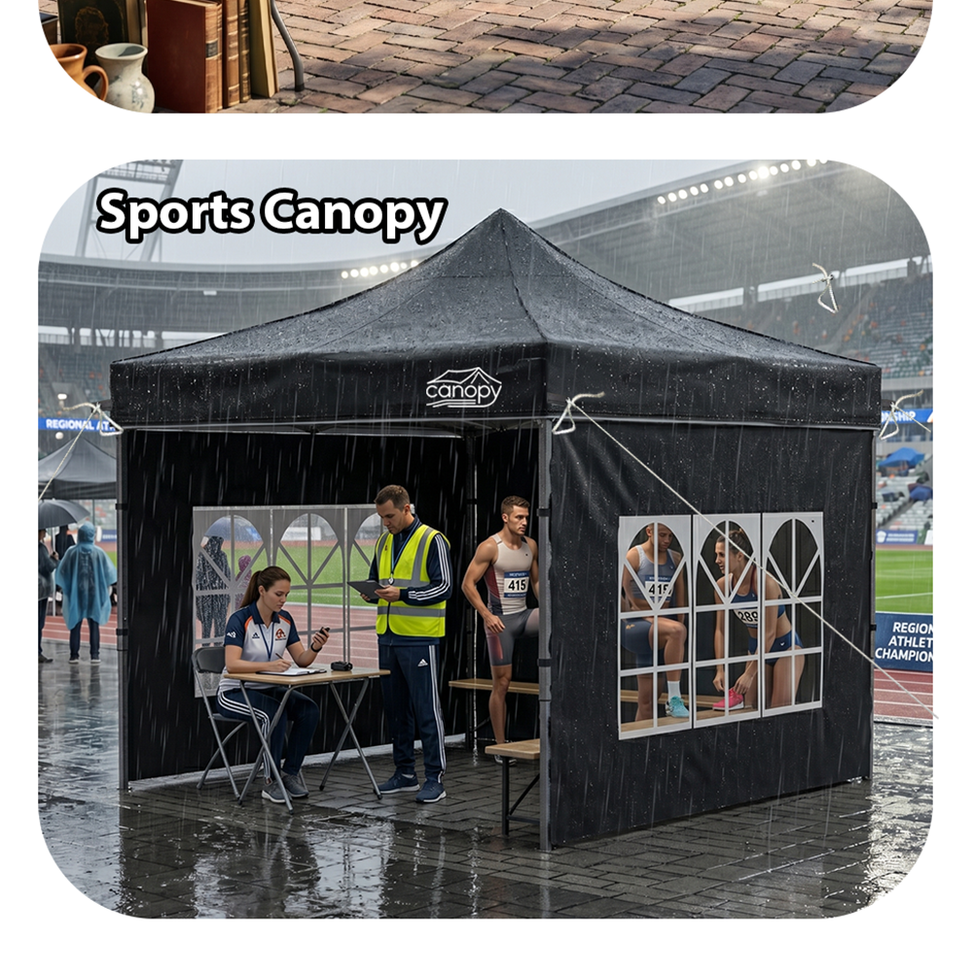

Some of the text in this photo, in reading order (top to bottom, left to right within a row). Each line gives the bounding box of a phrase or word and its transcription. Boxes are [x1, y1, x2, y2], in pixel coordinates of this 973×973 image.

[425, 384, 503, 408] canopy
[45, 418, 95, 431] REGIONAL
[508, 579, 527, 591] 415
[888, 635, 933, 649] ATHLET
